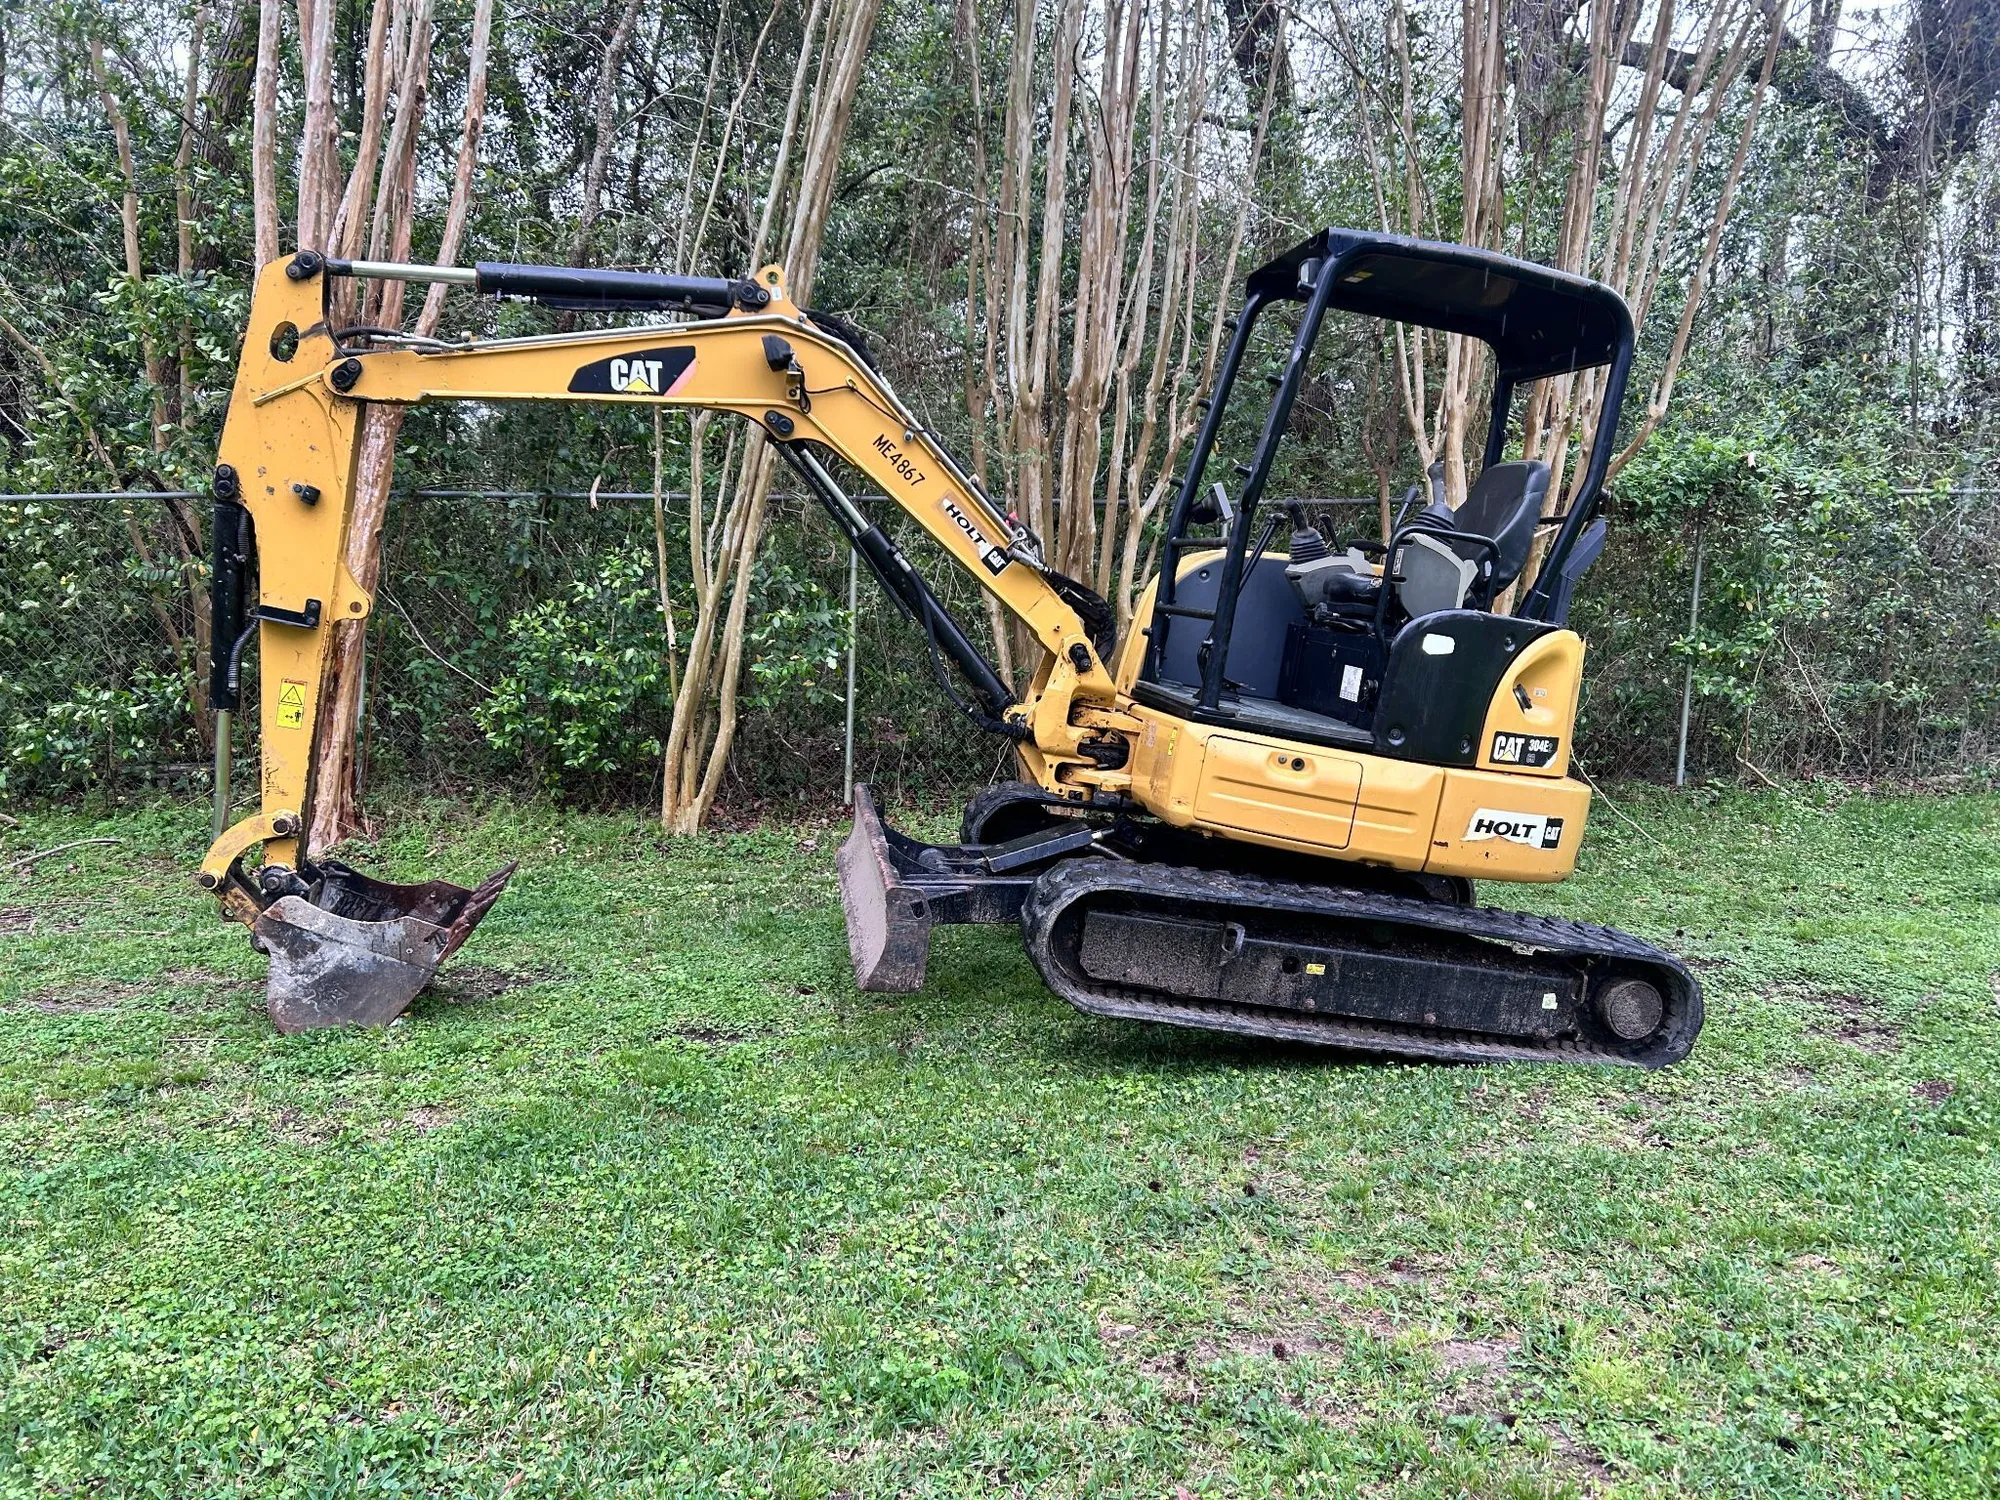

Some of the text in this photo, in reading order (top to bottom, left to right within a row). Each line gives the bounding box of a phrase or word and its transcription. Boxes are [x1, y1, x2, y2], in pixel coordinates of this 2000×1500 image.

[610, 358, 663, 393] CAT
[872, 433, 926, 487] ME4867
[945, 503, 1007, 569] HOLT CAT
[1493, 735, 1526, 762] CAT
[1474, 818, 1561, 841] HOLT CAT
